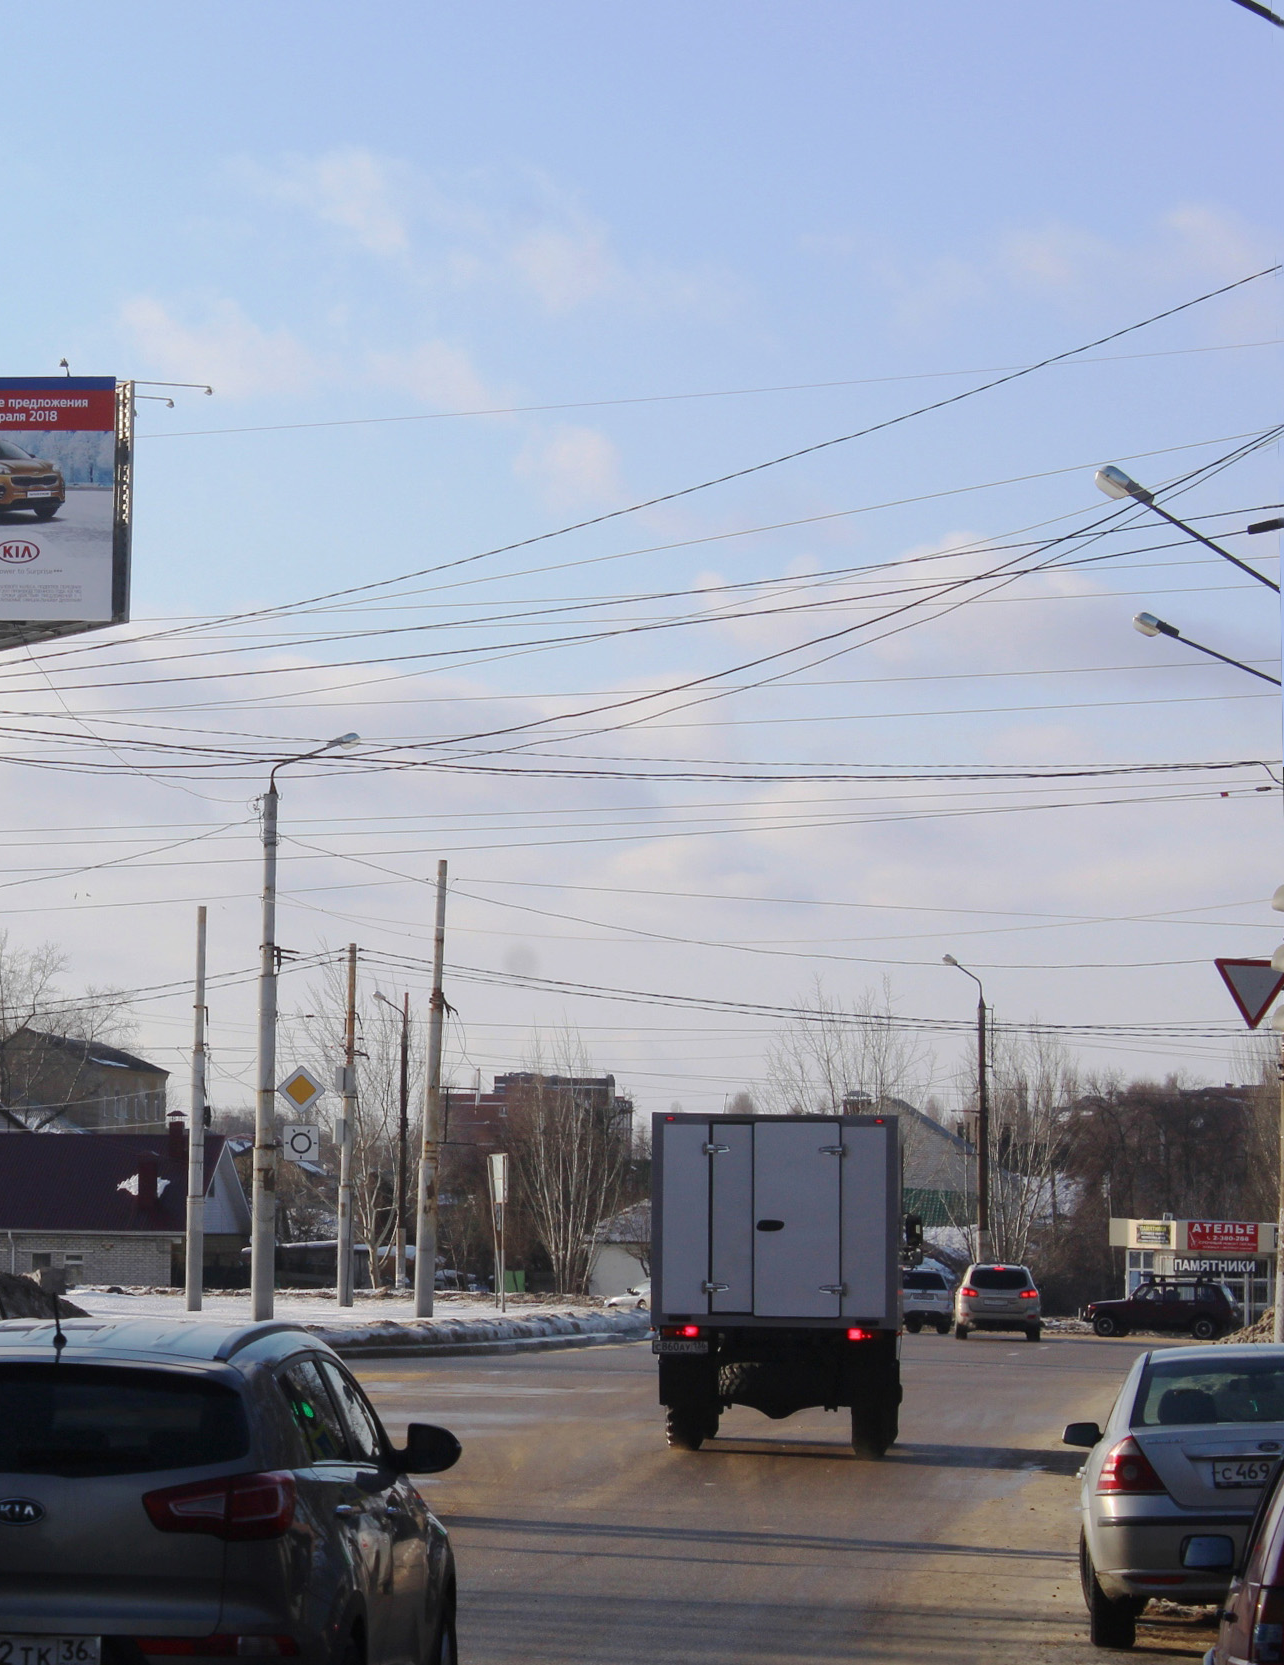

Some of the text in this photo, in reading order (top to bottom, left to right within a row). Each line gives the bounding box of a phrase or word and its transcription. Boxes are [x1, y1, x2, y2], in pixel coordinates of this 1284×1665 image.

[8, 399, 88, 409] предложения
[29, 411, 58, 422] 2018
[2, 545, 32, 558] KIA
[1192, 1223, 1255, 1234] АТЕЛЬЕ
[1174, 1259, 1256, 1272] ПАМЯТНИКИ
[62, 1640, 89, 1661] 36
